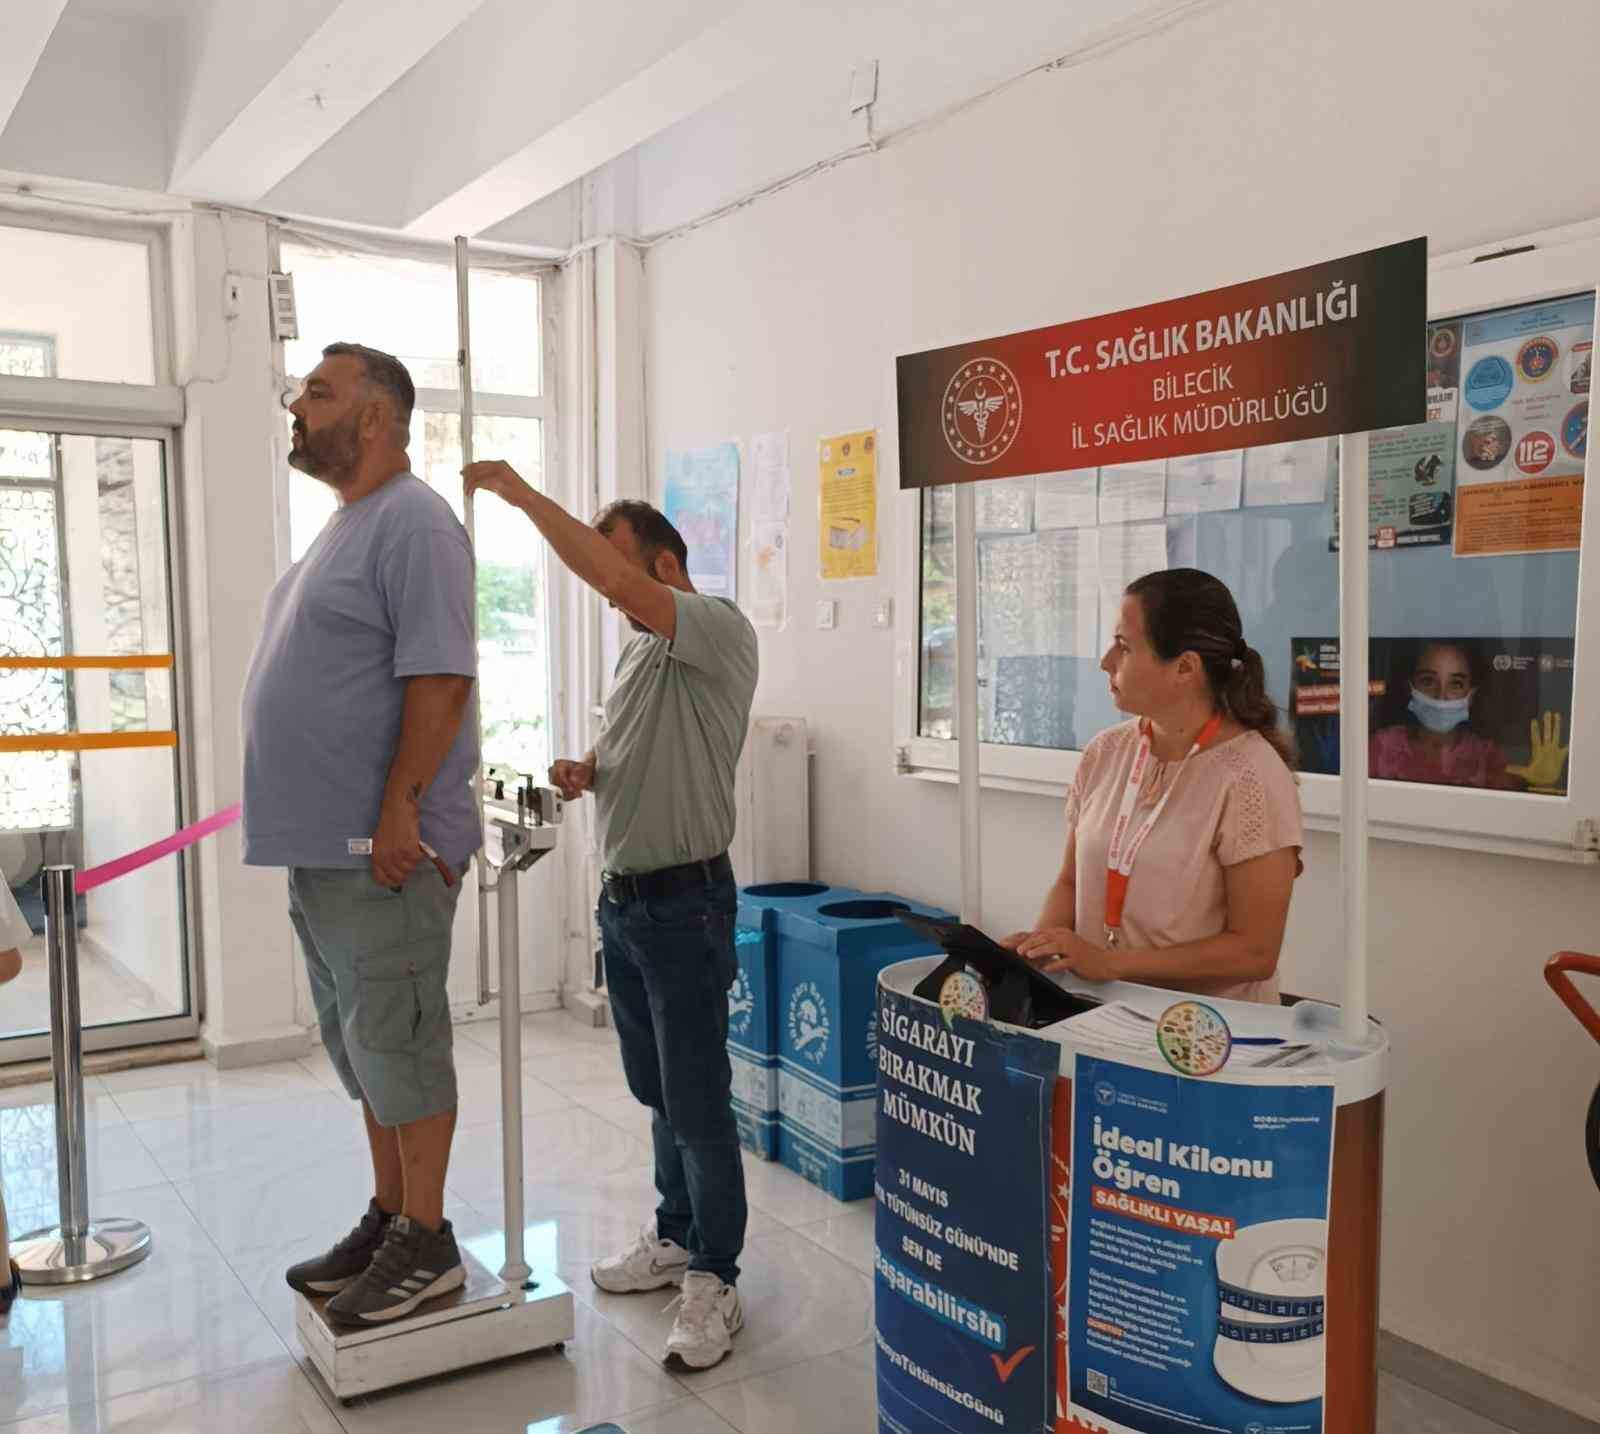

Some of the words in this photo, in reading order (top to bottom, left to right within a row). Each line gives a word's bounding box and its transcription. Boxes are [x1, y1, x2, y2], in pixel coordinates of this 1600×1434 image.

[1045, 347, 1090, 379] T.C.
[1096, 322, 1189, 371] SAĞLIK
[1195, 278, 1359, 353] BAKANLIĞI
[1152, 364, 1234, 402] BİLECİK
[1071, 421, 1089, 450] İL
[1093, 412, 1168, 445] SAĞLIK
[1173, 382, 1328, 435] MÜDÜRLÜĞÜ
[1518, 439, 1549, 464] 112
[881, 1003, 976, 1068] SİGARAYI
[879, 1044, 983, 1116] BIRAKMAK
[883, 1088, 976, 1156] MÜMKÜN
[1091, 1149, 1181, 1200] Öğren
[1168, 1140, 1274, 1179] Kilonu
[898, 1168, 910, 1190] 31
[912, 1177, 949, 1208] MAYIS
[1095, 1189, 1171, 1224] SAĞLIKLI
[1172, 1211, 1232, 1237] YAŞA!
[885, 1190, 943, 1240] TÜTÜNSÜZ
[944, 1226, 1019, 1272] GÜNÜ'NDE
[902, 1235, 923, 1261] SEN
[925, 1247, 943, 1272] DE
